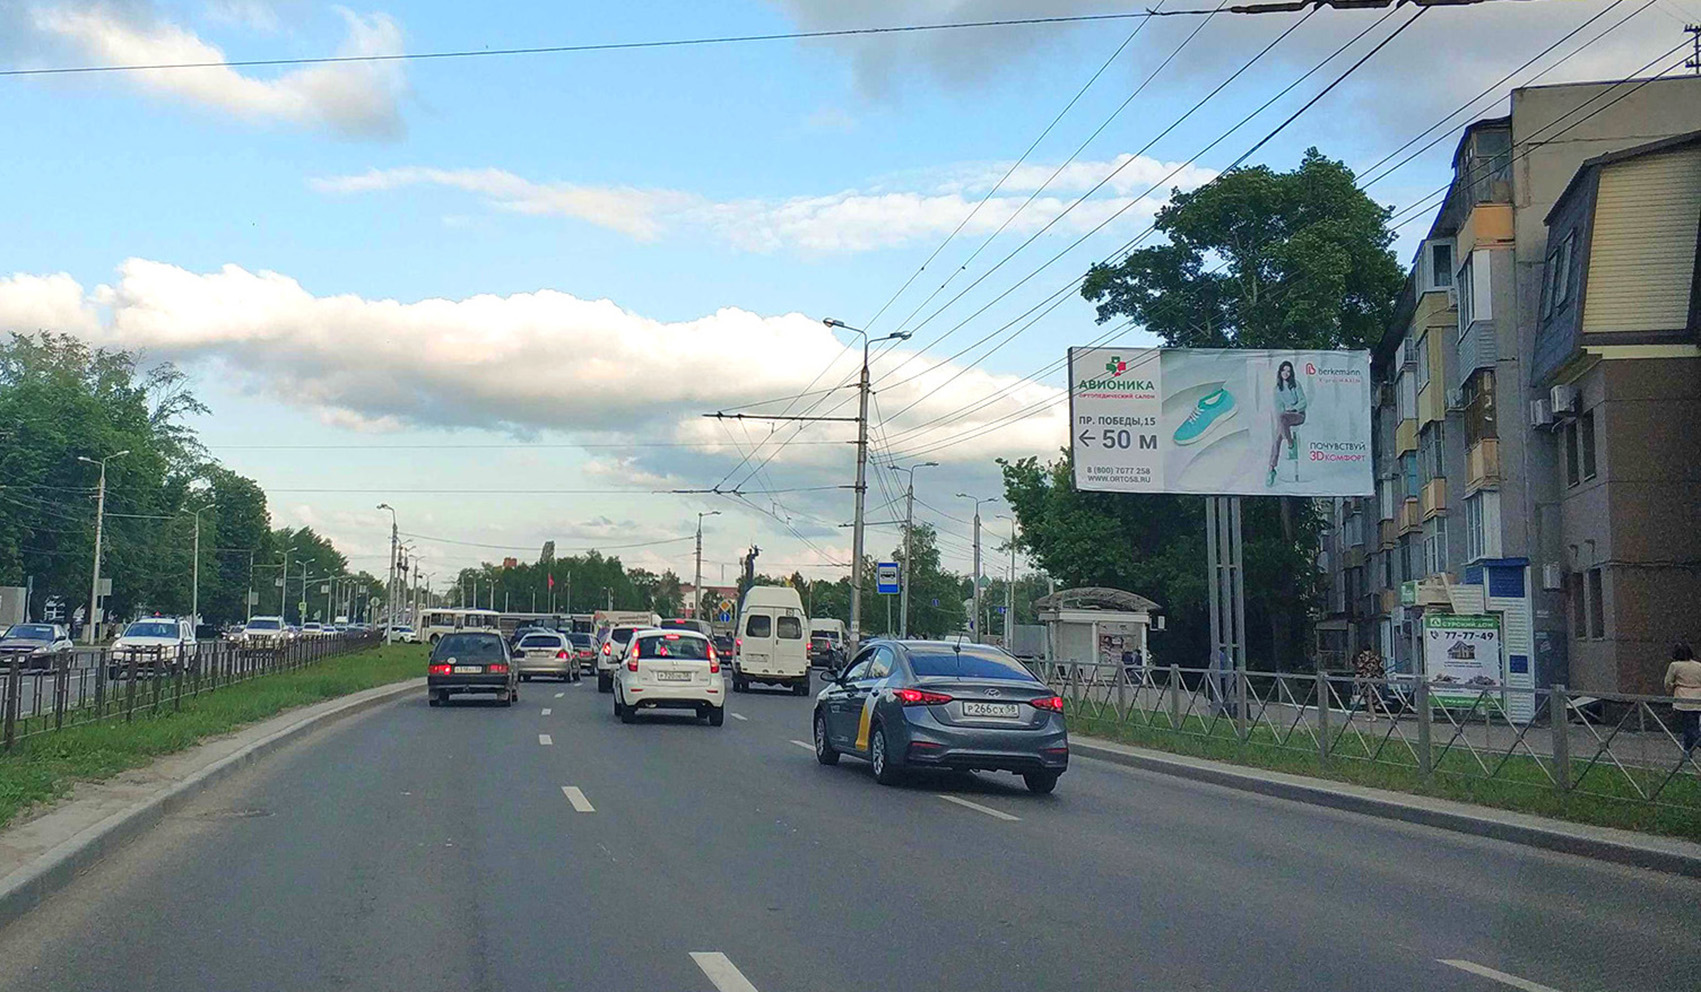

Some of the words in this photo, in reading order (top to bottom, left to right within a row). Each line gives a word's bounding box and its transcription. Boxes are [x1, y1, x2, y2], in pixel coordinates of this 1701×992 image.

[1080, 380, 1154, 390] АВИОНИКА
[1079, 416, 1095, 424] ПР.
[1098, 416, 1156, 427] ПОБЕДЫ,15
[1102, 429, 1131, 449] 50
[1310, 441, 1365, 450] ПОЧУВСТВУЙ
[1087, 466, 1092, 474] 8
[1093, 466, 1114, 474] (800)
[1115, 467, 1134, 475] 7077
[1136, 467, 1151, 475] 258
[1444, 631, 1494, 640] 77-77-49
